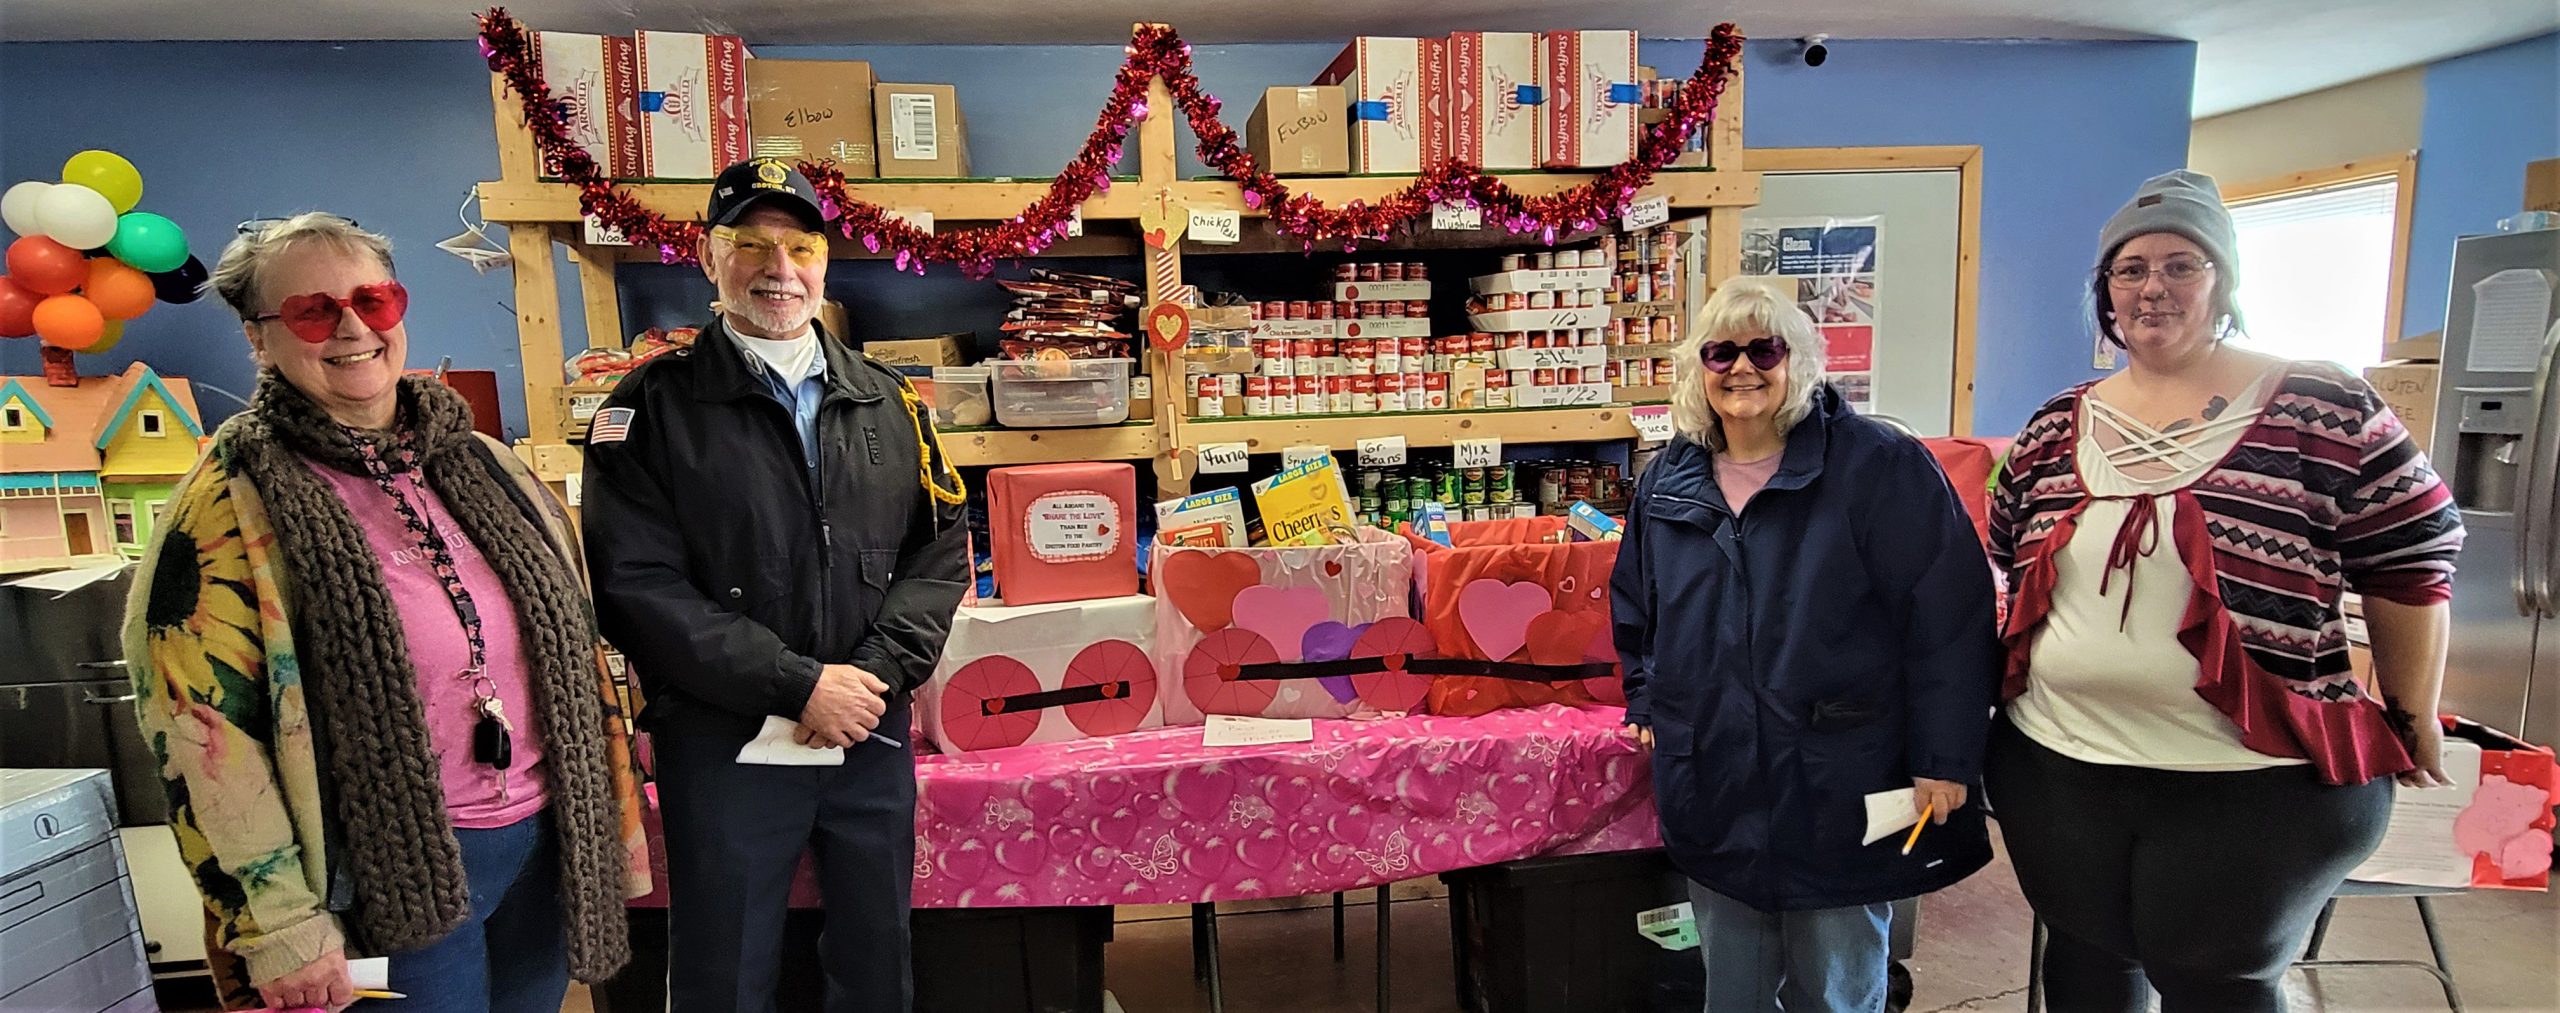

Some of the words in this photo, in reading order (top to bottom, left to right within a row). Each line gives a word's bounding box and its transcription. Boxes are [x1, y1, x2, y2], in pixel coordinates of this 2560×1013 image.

[617, 39, 632, 95] Stuffing
[719, 37, 735, 94] Stuffing
[1427, 42, 1443, 92] Stuffing
[1458, 35, 1471, 88] Stuffing
[1556, 34, 1569, 86] Stuffing
[578, 81, 591, 132] ARNOLD
[681, 79, 693, 129] ARNOLD
[783, 107, 834, 128] Elbow
[1394, 81, 1404, 129] ARNOLD
[1497, 77, 1505, 125] ARNOLD
[625, 123, 638, 177] Stuffing
[1430, 120, 1444, 163] tuffing
[1458, 113, 1471, 163] Stuffing
[1556, 112, 1570, 162] Stuffing
[1782, 236, 1813, 252] Clean.
[1359, 453, 1402, 465] Beans
[1464, 457, 1492, 468] Veg.
